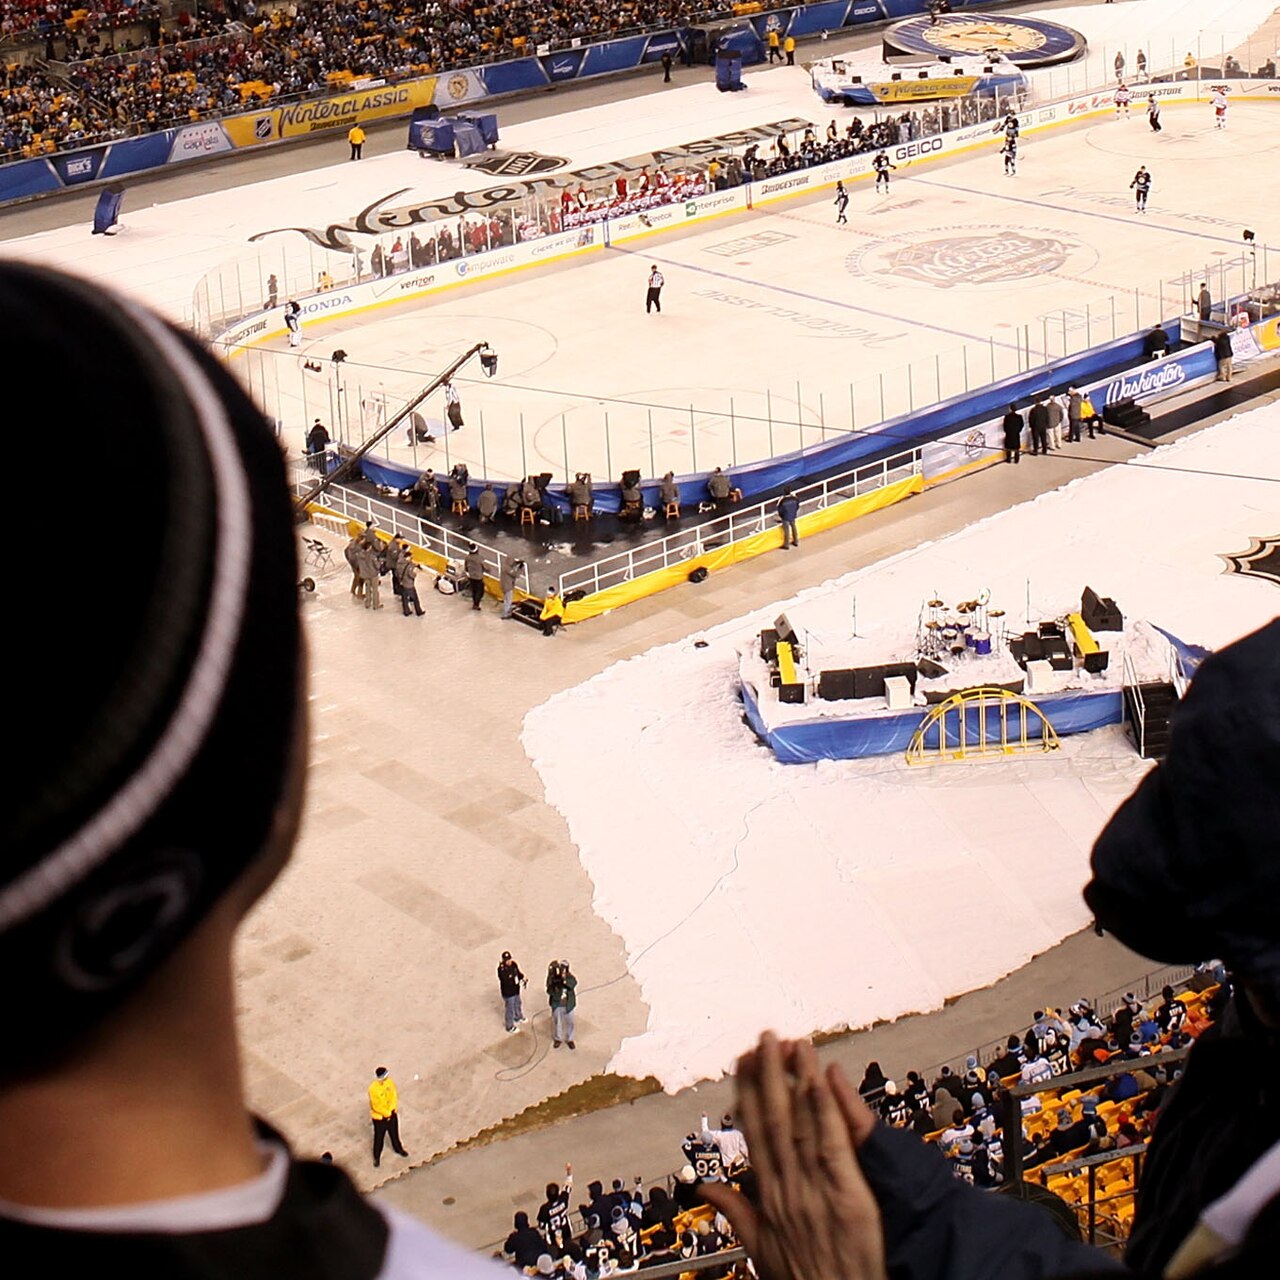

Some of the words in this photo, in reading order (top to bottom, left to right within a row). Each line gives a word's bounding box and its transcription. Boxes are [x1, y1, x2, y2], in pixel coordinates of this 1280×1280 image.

[854, 6, 877, 15] GEICO
[1128, 86, 1183, 100] BRIDGESTONE
[272, 101, 340, 138] Winter
[340, 89, 408, 116] CLASSIC
[896, 138, 943, 161] GEICO
[761, 175, 810, 195] BRIDGESTONE
[248, 176, 573, 253] Winter
[400, 274, 435, 290] verizon
[299, 295, 352, 316] HONDA
[1106, 362, 1185, 405] Washington
[696, 1160, 720, 1177] 93
